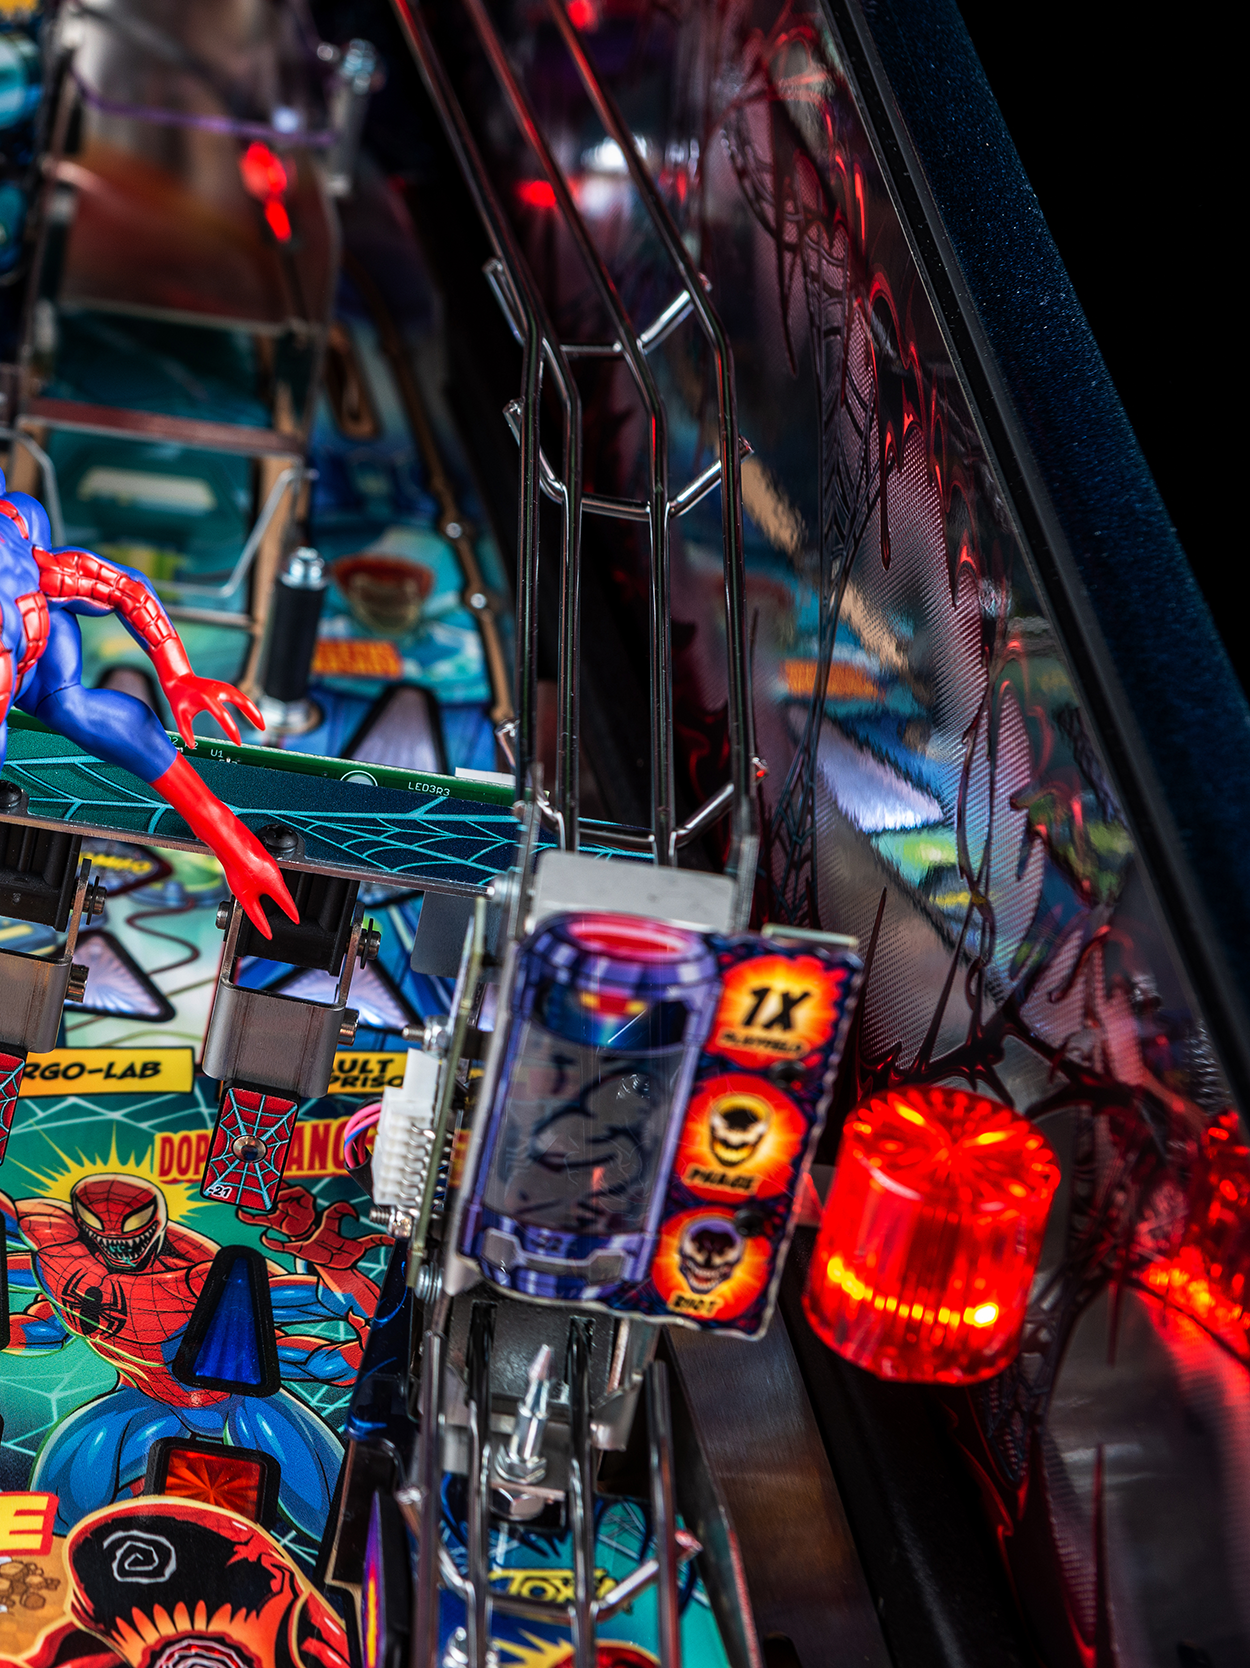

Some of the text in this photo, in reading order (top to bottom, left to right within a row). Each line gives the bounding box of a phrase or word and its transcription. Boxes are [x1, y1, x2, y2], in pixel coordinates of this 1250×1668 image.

[210, 748, 223, 759] U1
[743, 987, 812, 1031] 1X
[208, 1185, 231, 1198] -21
